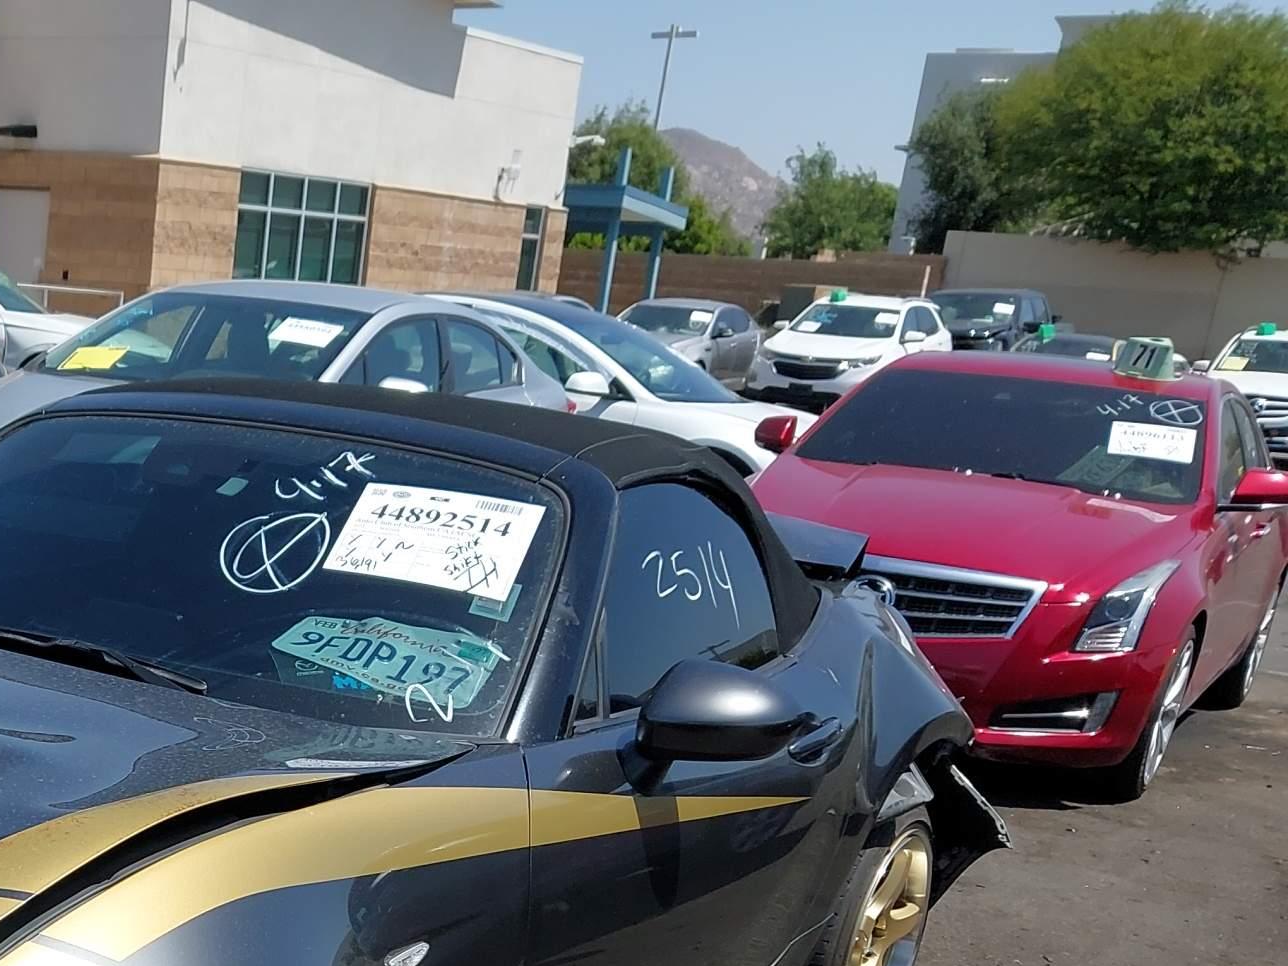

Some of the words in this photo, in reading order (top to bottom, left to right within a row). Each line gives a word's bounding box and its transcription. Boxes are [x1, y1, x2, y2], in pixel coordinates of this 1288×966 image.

[1132, 344, 1159, 369] 71
[370, 503, 512, 537] 44892514
[641, 541, 740, 630] 2514
[289, 631, 473, 695] 9FDP197
